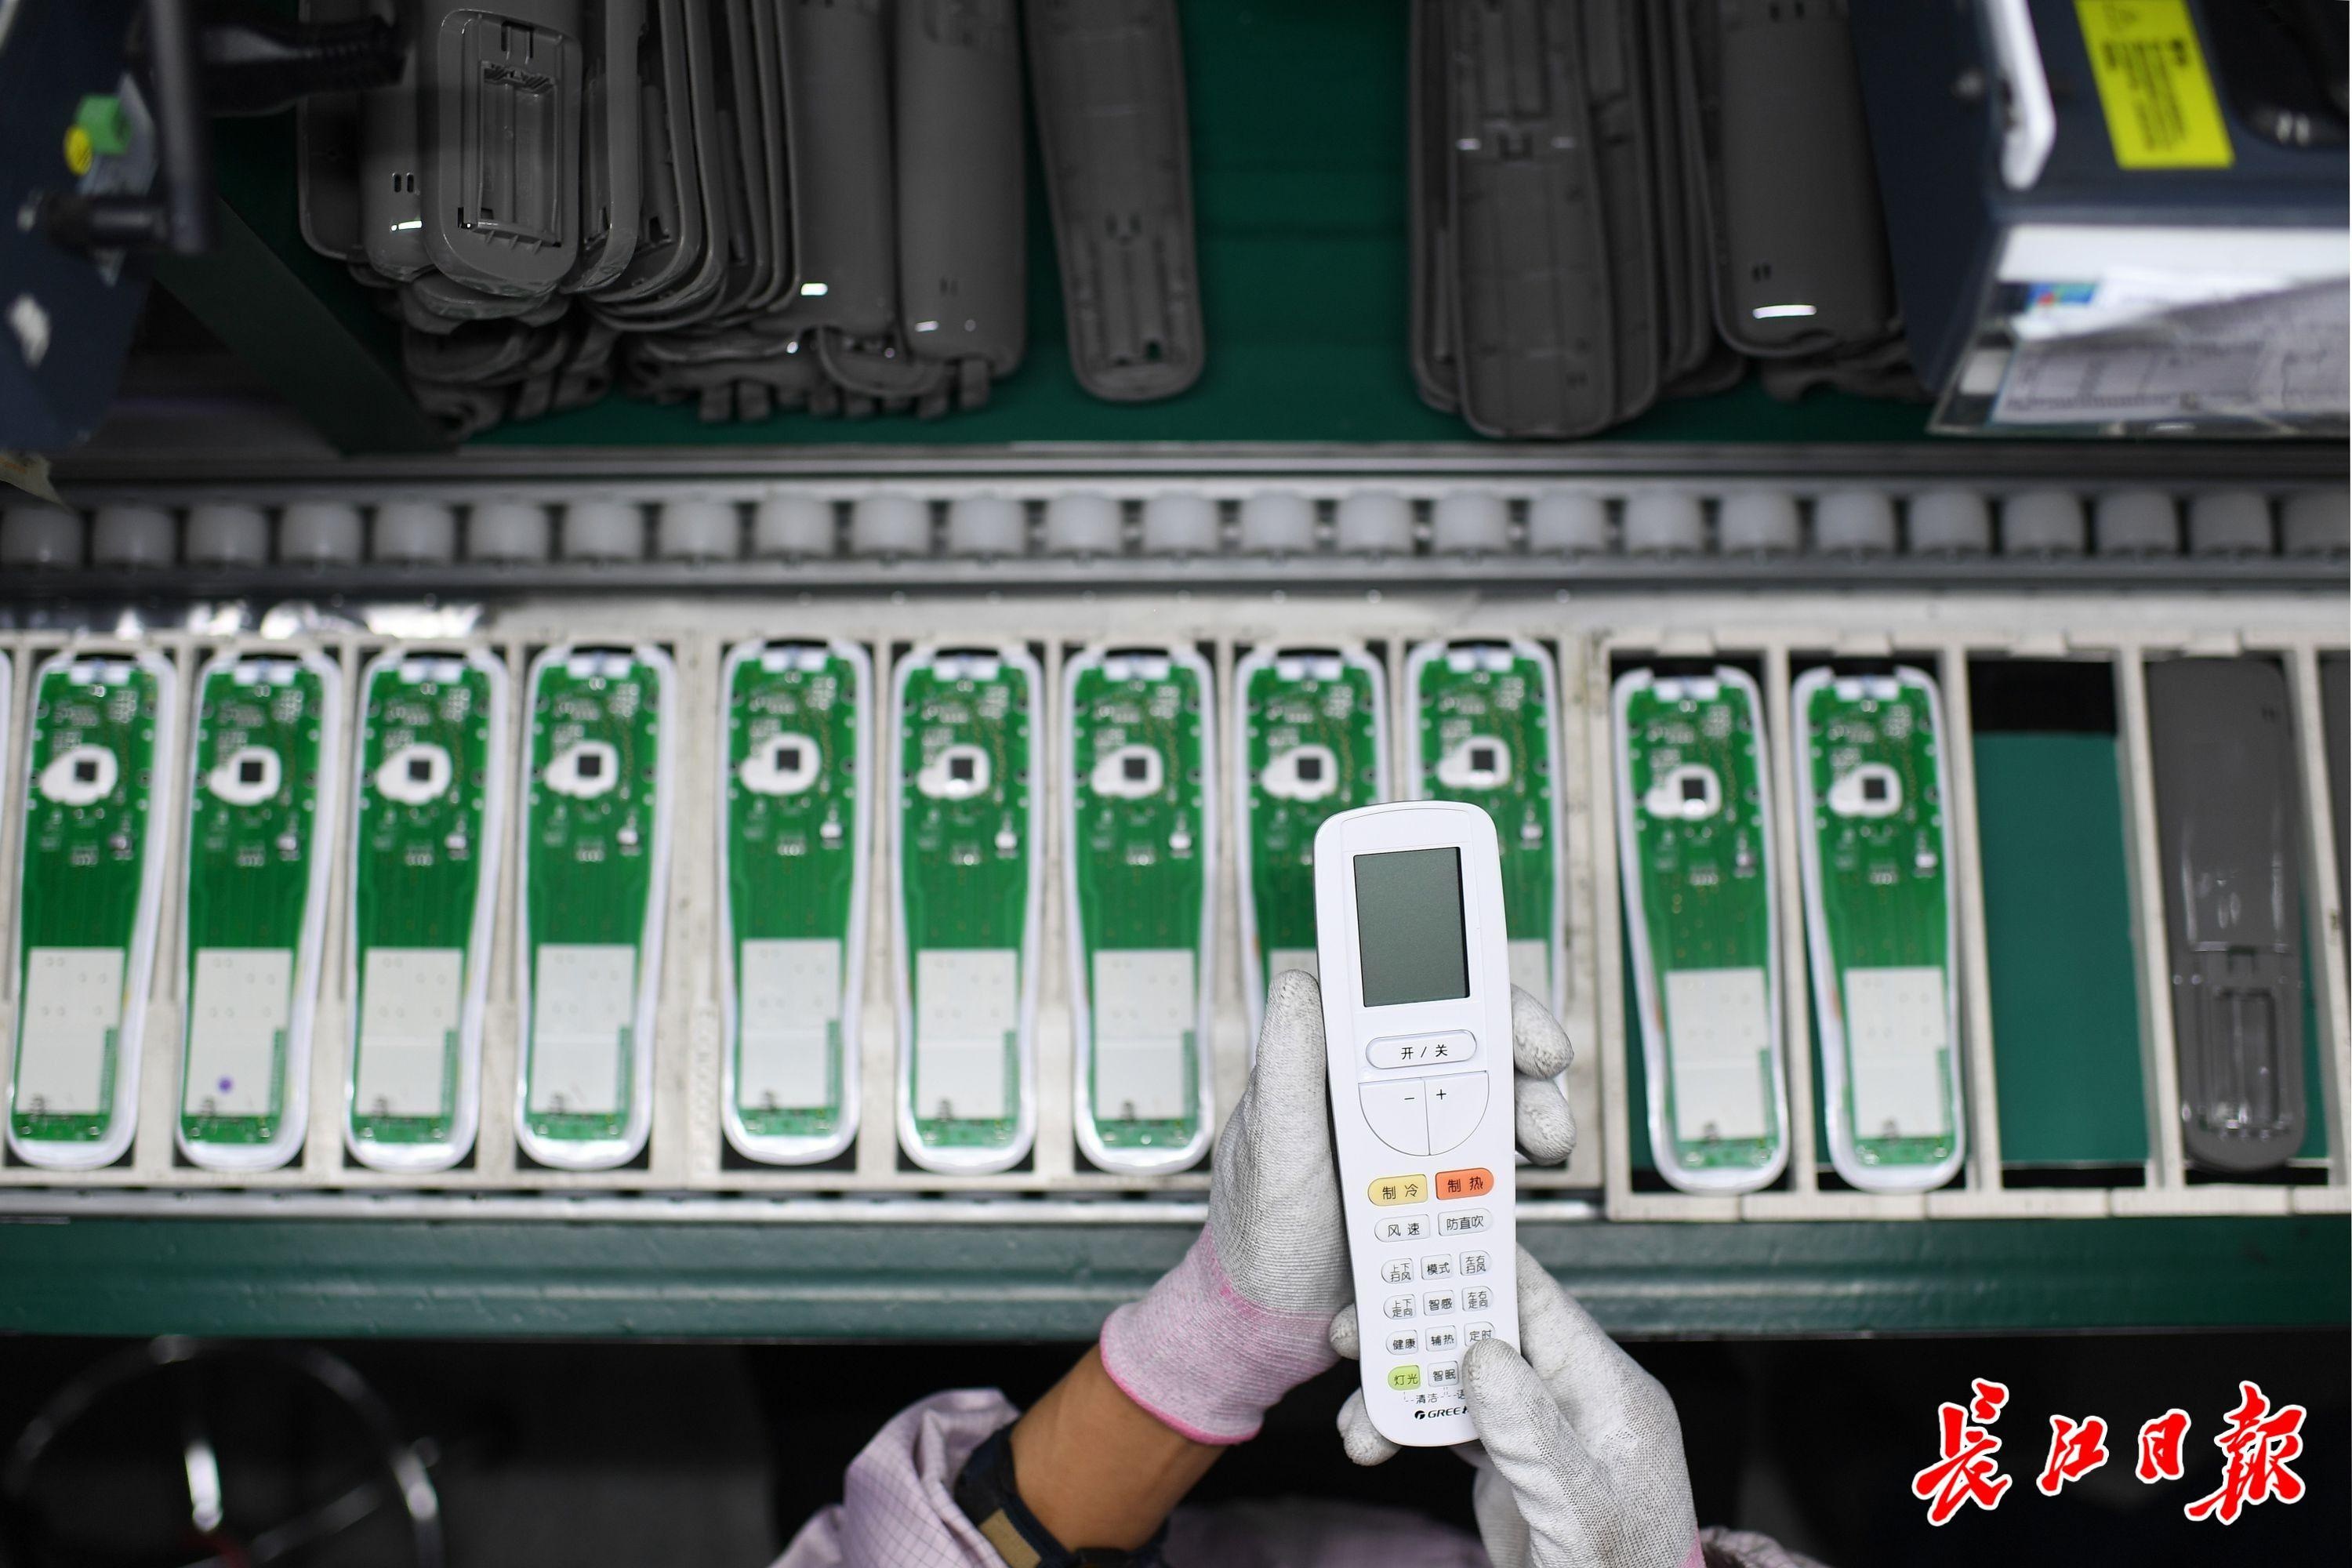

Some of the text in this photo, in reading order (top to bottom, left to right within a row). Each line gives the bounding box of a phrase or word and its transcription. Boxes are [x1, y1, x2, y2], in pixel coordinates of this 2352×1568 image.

[1447, 1176, 1484, 1193] 制热
[1381, 1183, 1419, 1200] 制冷
[1446, 1214, 1485, 1231] 防直吹
[1387, 1222, 1421, 1238] 风速
[1465, 1255, 1485, 1265] 左右
[1390, 1263, 1410, 1273] 上下
[1426, 1262, 1450, 1276] 模式
[1467, 1290, 1487, 1301] 左右
[1392, 1299, 1412, 1309] 上下
[1428, 1298, 1454, 1311] 智感
[1430, 1334, 1454, 1346] 辅热
[1468, 1329, 1492, 1342] 定时
[1392, 1338, 1417, 1350] 健康
[1394, 1373, 1419, 1386] 灯光
[1432, 1369, 1457, 1382] 智眠
[1416, 1393, 1438, 1404] 清洁
[1428, 1406, 1461, 1418] GREE
